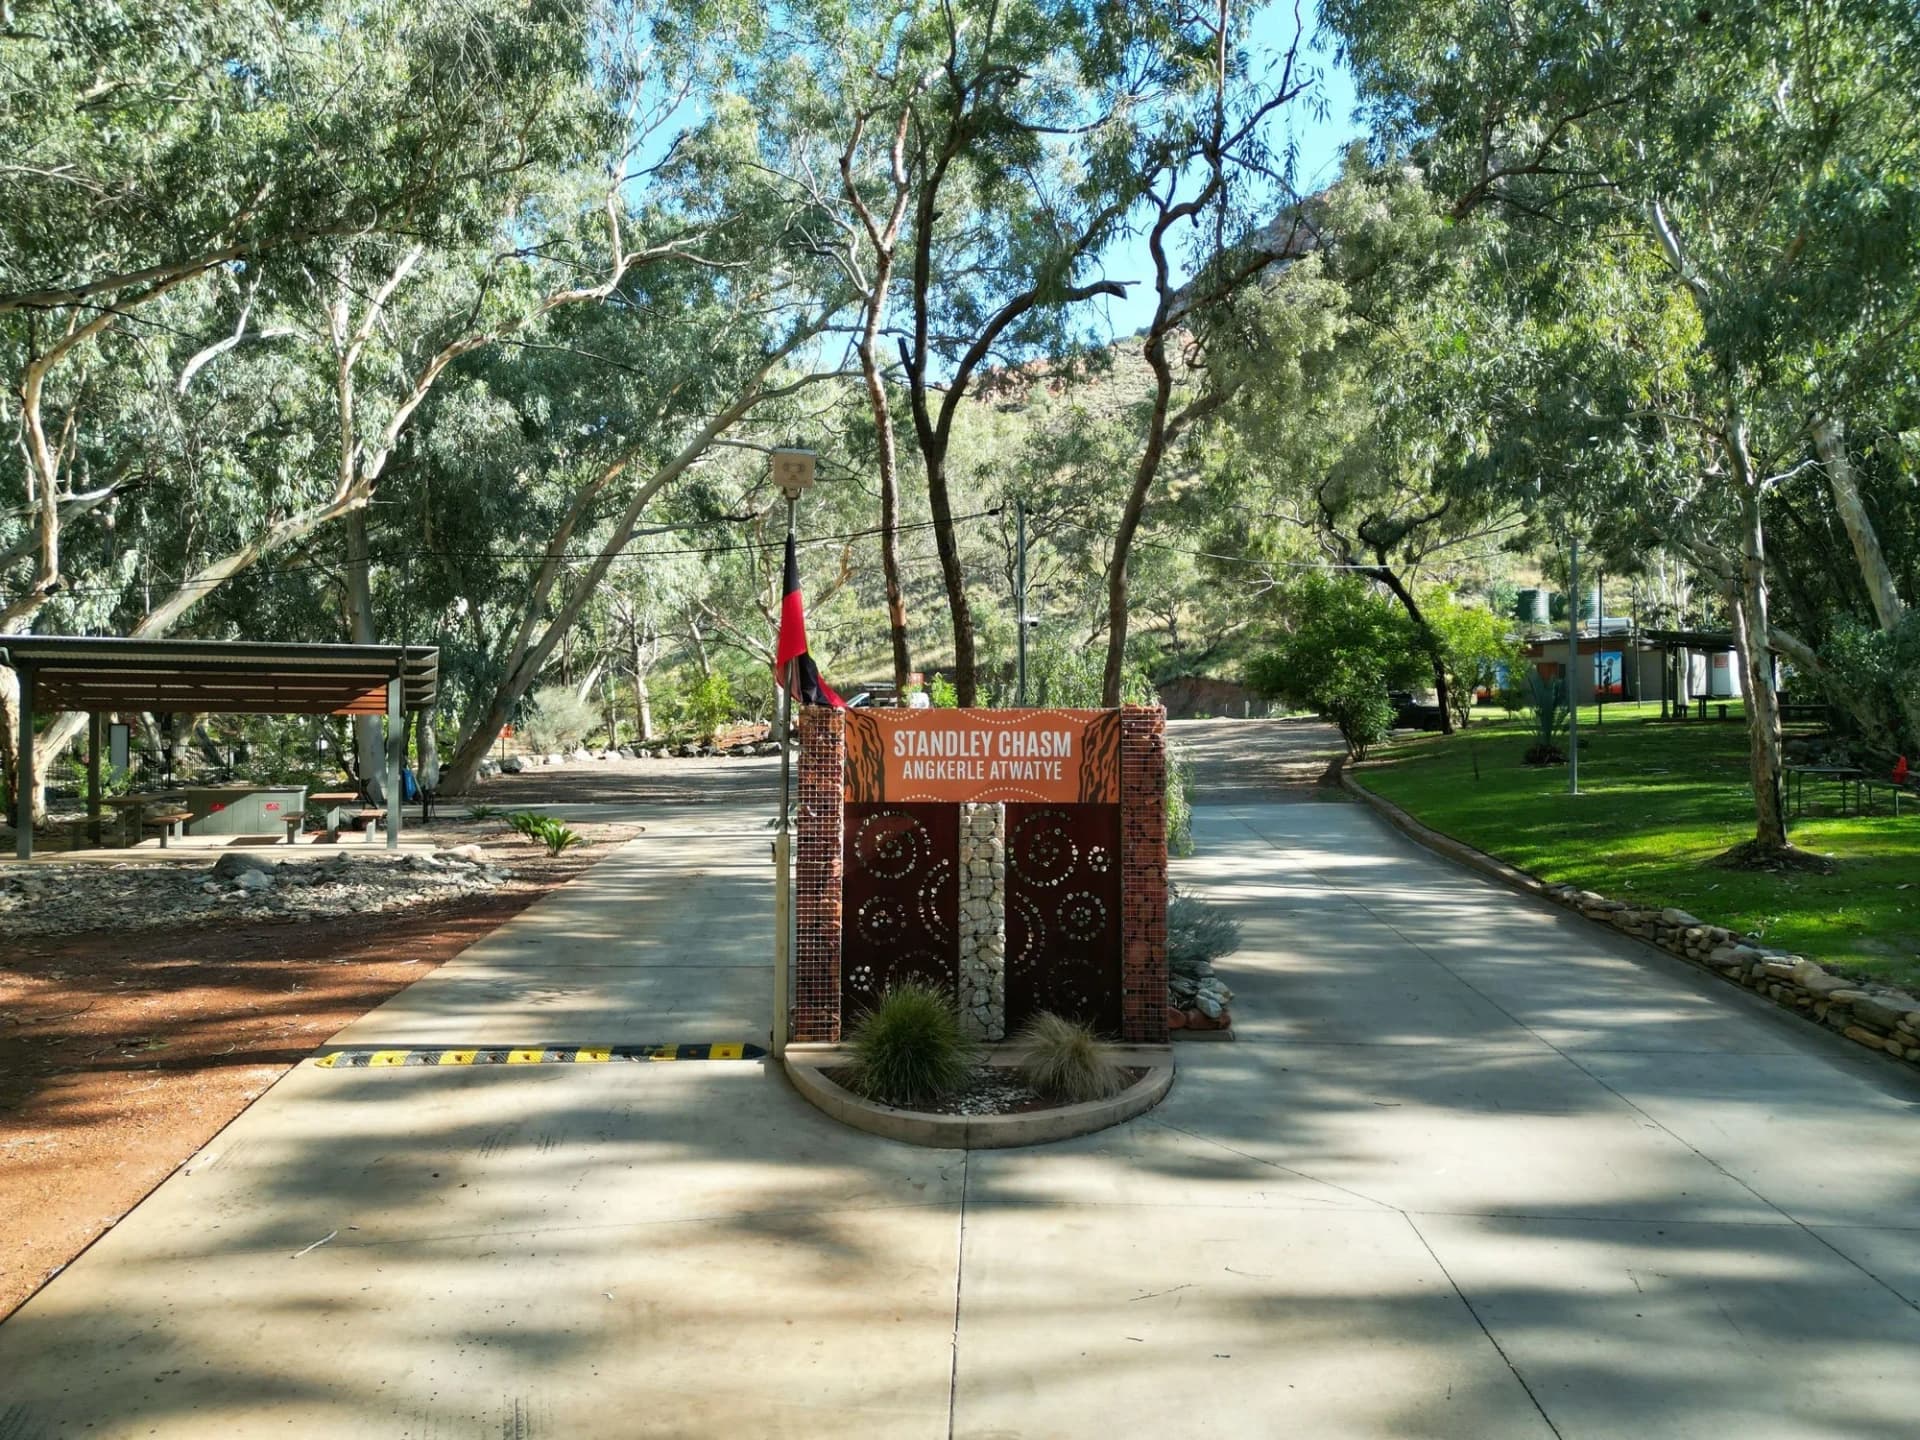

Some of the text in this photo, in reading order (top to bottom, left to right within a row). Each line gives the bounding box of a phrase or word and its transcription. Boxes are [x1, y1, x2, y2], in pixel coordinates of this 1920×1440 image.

[894, 730, 1071, 757] STANDLEY CHASM
[902, 760, 1062, 780] ANGKERLE ATWATYE
